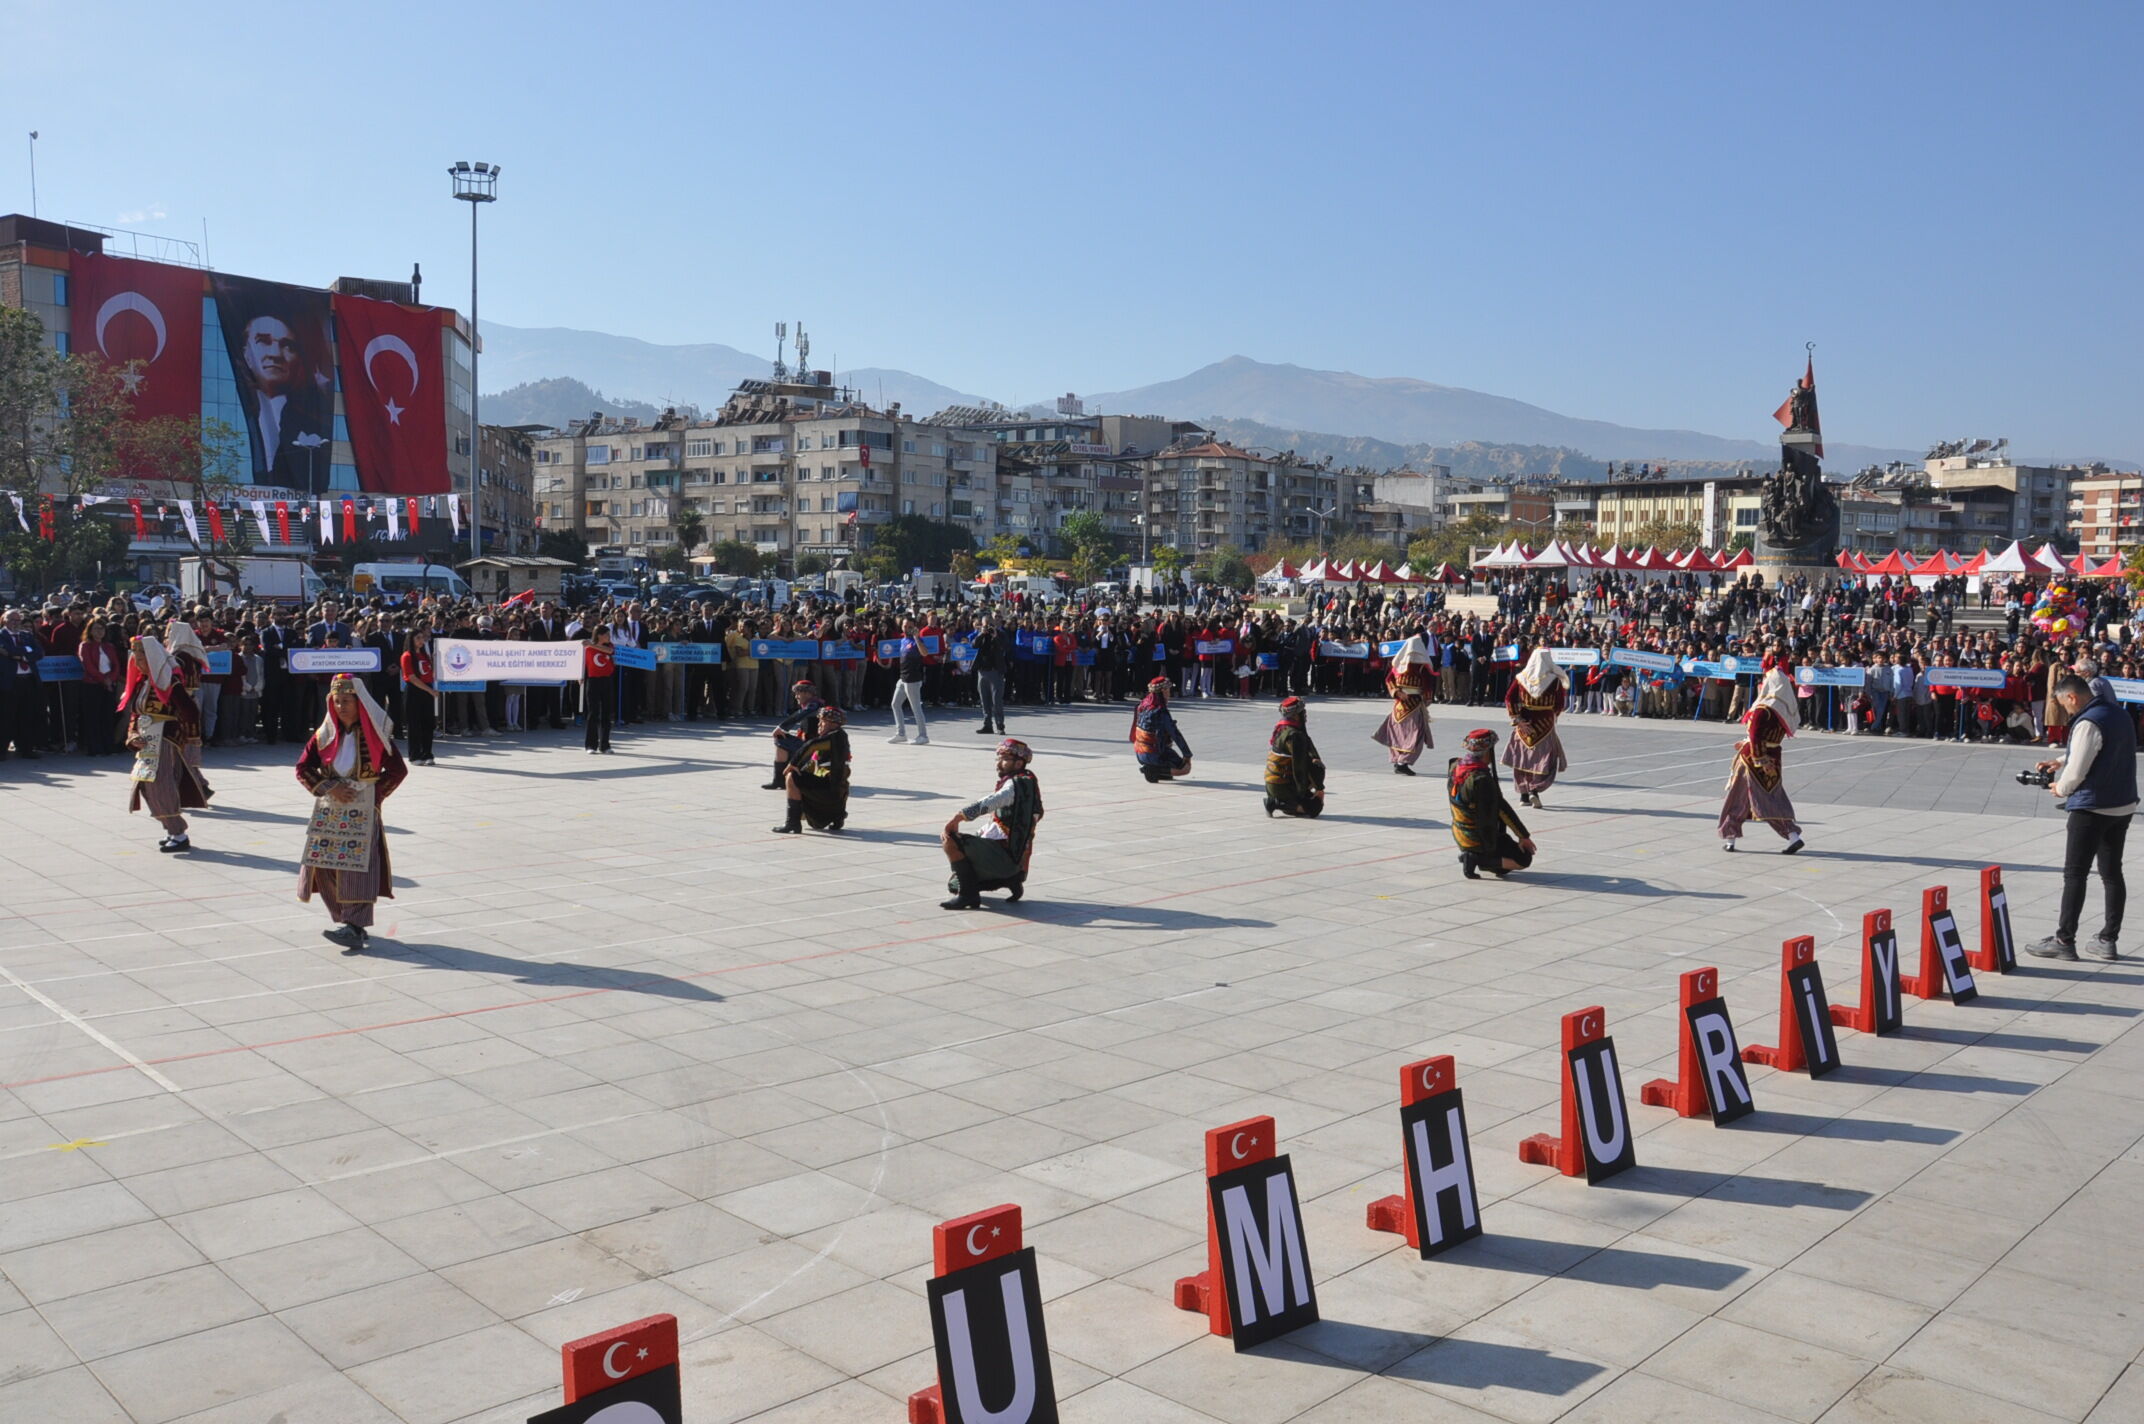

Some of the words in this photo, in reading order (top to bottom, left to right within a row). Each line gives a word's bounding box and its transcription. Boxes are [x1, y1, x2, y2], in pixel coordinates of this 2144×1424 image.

[232, 486, 271, 501] Doğru
[476, 647, 504, 657] SALİHLİ
[505, 648, 527, 658] ŞEHİT
[528, 649, 552, 657] AHMET
[553, 648, 577, 657] ÖZSOY
[487, 660, 507, 668] HALK
[508, 659, 534, 668] EĞİTİMİ
[536, 659, 567, 668] MERKEZİ
[1932, 916, 1974, 994] E
[1991, 892, 2011, 962] T
[1873, 938, 1896, 1021] Y
[1694, 1012, 1751, 1113] R
[1574, 1048, 1625, 1164] U
[1412, 1107, 1477, 1245] H
[1222, 1172, 1310, 1327] M
[942, 1269, 1036, 1424] U
